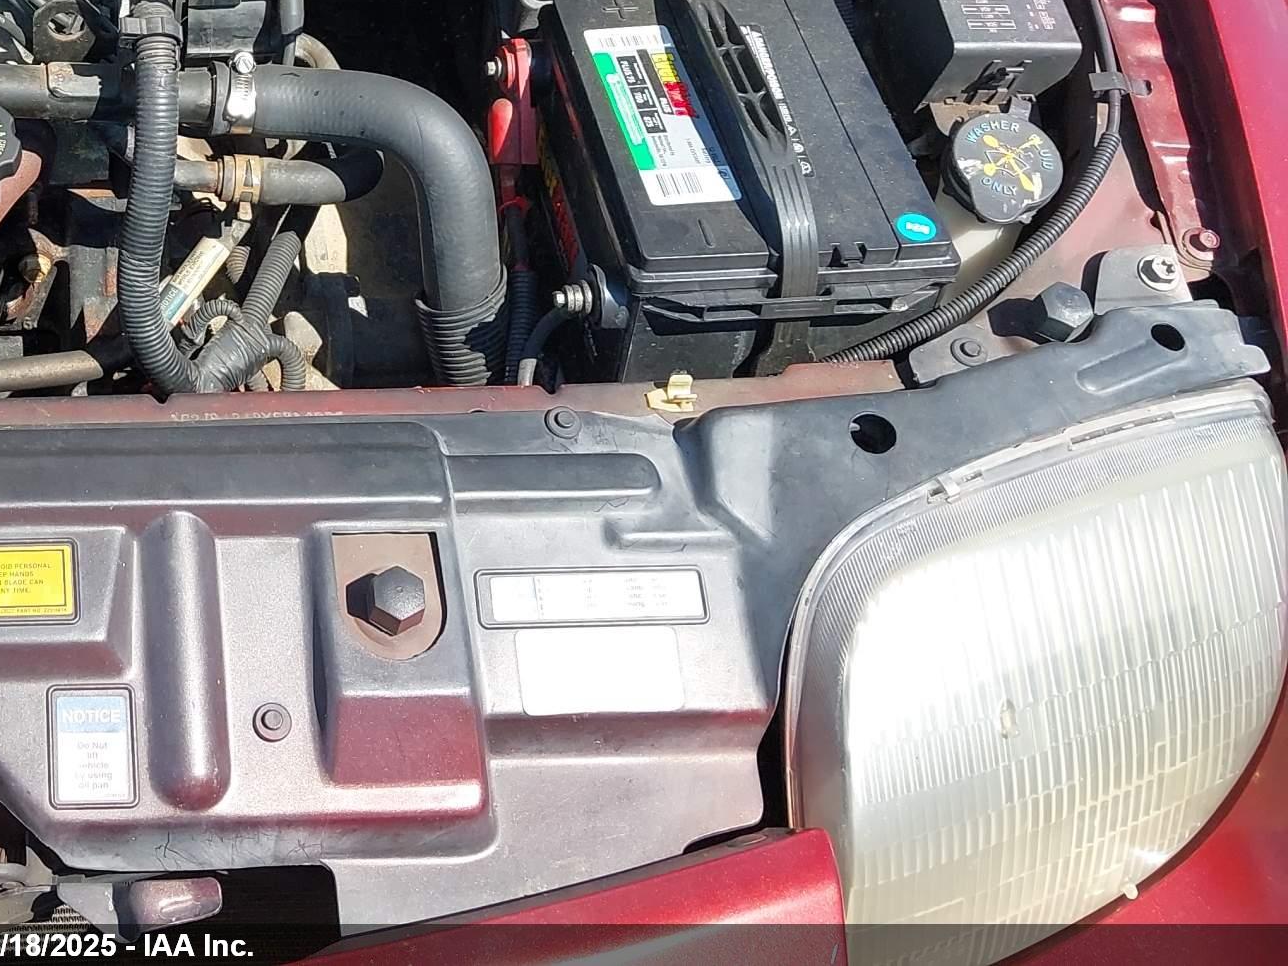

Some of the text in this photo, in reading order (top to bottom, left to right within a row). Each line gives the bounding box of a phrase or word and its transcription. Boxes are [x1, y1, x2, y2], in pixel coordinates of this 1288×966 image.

[965, 120, 1054, 170] WASHER UID
[981, 177, 1018, 195] ONLY
[62, 708, 120, 723] NOTICE
[87, 772, 113, 781] using
